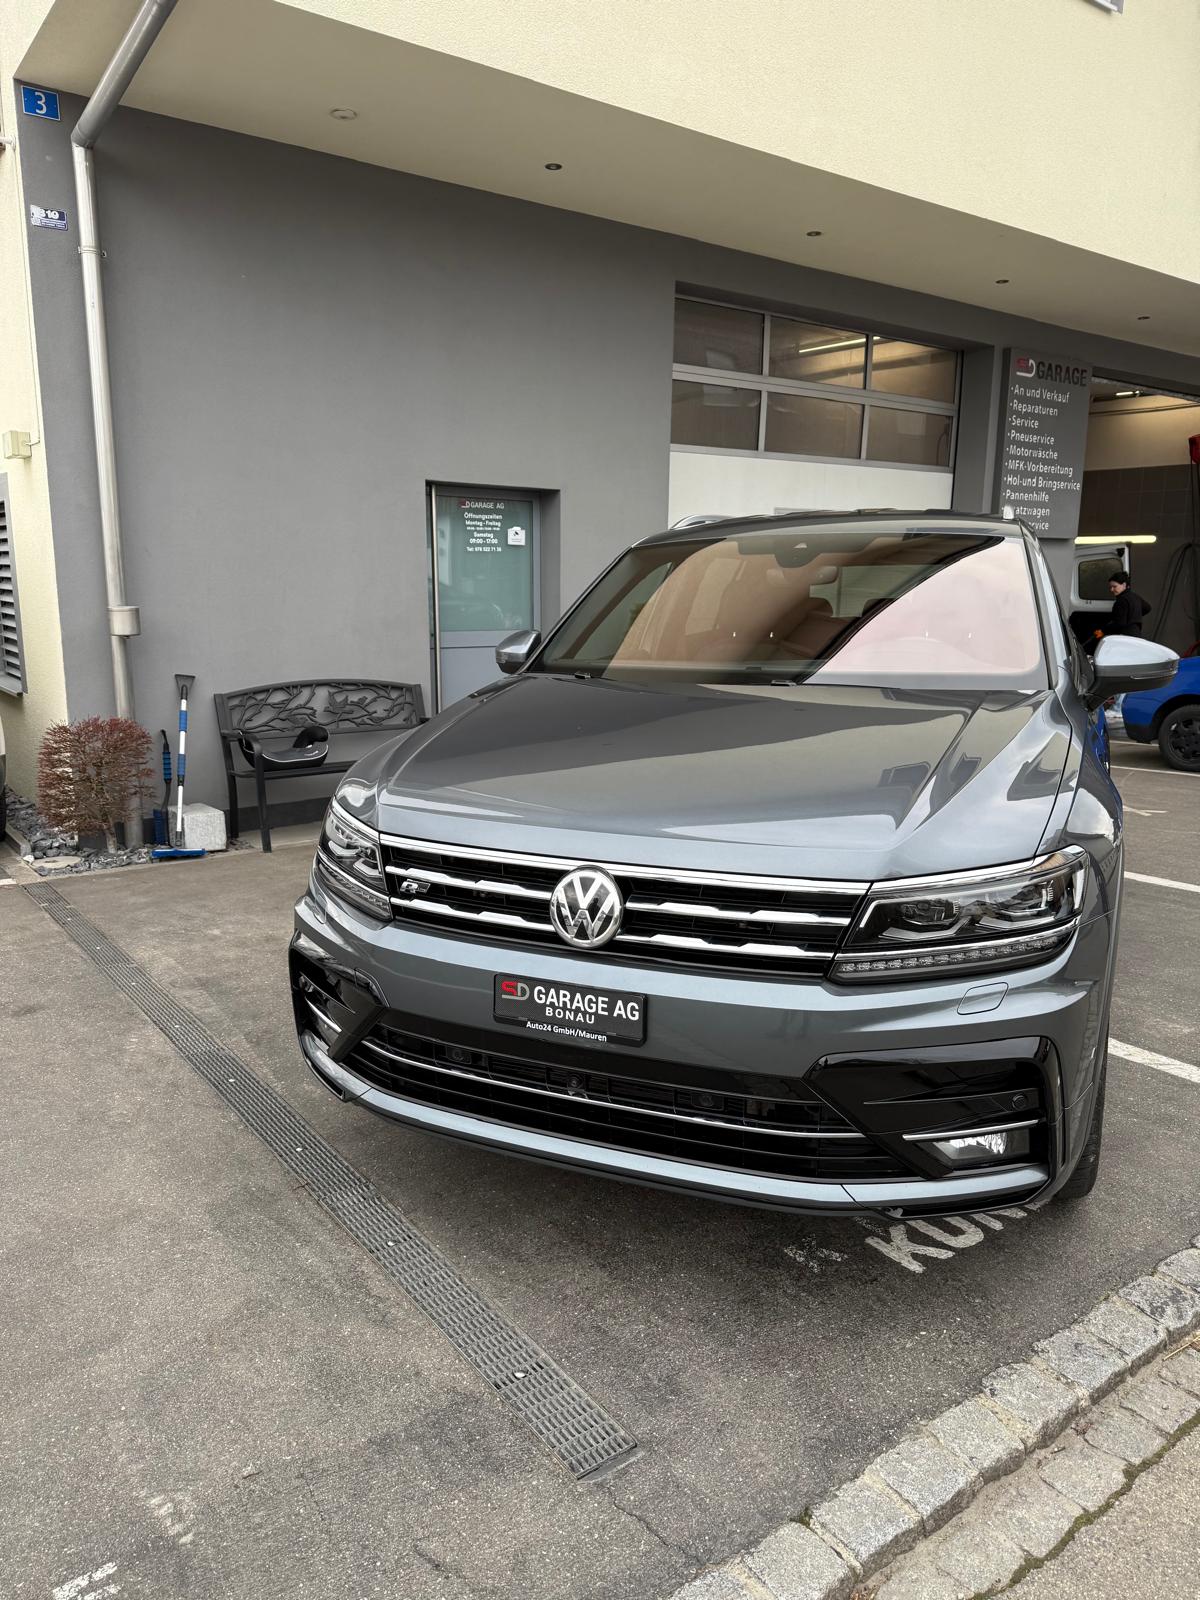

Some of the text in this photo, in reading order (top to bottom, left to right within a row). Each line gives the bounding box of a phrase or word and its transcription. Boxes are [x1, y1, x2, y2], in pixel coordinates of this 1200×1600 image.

[34, 91, 47, 114] 3
[1037, 361, 1088, 387] GARAGE
[1014, 384, 1070, 403] An und Verkauf
[1012, 399, 1058, 416] Reparaturen
[1011, 415, 1039, 428] Service
[1010, 429, 1055, 445] Pneuservice
[1009, 444, 1058, 460] Motorwäsche
[1007, 459, 1074, 478] MFK-Vorbereitung
[1038, 476, 1081, 491] Bringservice
[1005, 489, 1050, 502] Pannenhilfe
[470, 501, 495, 509] GARAGE
[496, 502, 505, 510] AG
[1014, 506, 1050, 518] atzwagen
[463, 511, 503, 520] Öffnungszeiten
[465, 519, 483, 527] Montag
[533, 985, 609, 1016] GARAGE
[613, 999, 640, 1021] AG
[545, 1006, 595, 1024] BONAU
[526, 1020, 608, 1042] Auto24 GmbH/Mauren
